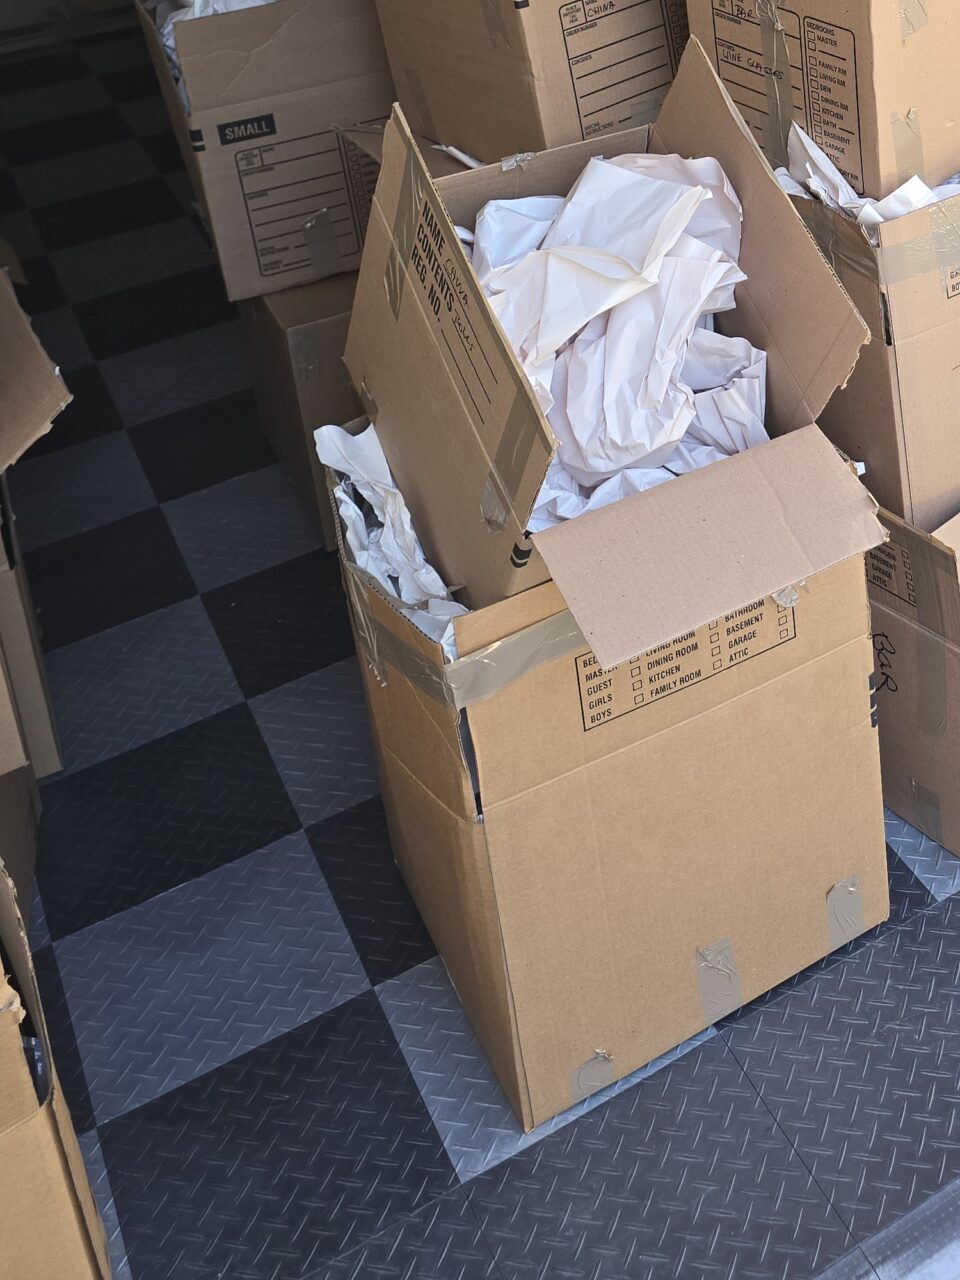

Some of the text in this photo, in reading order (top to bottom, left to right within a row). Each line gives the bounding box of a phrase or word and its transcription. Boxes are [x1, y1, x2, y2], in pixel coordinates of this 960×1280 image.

[806, 21, 835, 36] BEDROOMS
[816, 34, 838, 48] MASTER
[818, 60, 838, 72] FAMILY
[819, 72, 836, 84] LIVING
[820, 83, 832, 94] DEN
[821, 107, 844, 121] KITCHEN
[224, 121, 271, 140] SMALL
[823, 130, 851, 145] BASEMENT
[422, 200, 445, 257] NAME
[417, 223, 455, 313] CONTENTS
[411, 243, 441, 323] REG. NO.
[587, 613, 764, 696] GUEST DINING ROOM BASEMENT
[588, 629, 757, 710] GIRLS KITCHEN GARAGE
[590, 647, 749, 724] BOYS FAMILY ROOM ATTIC
